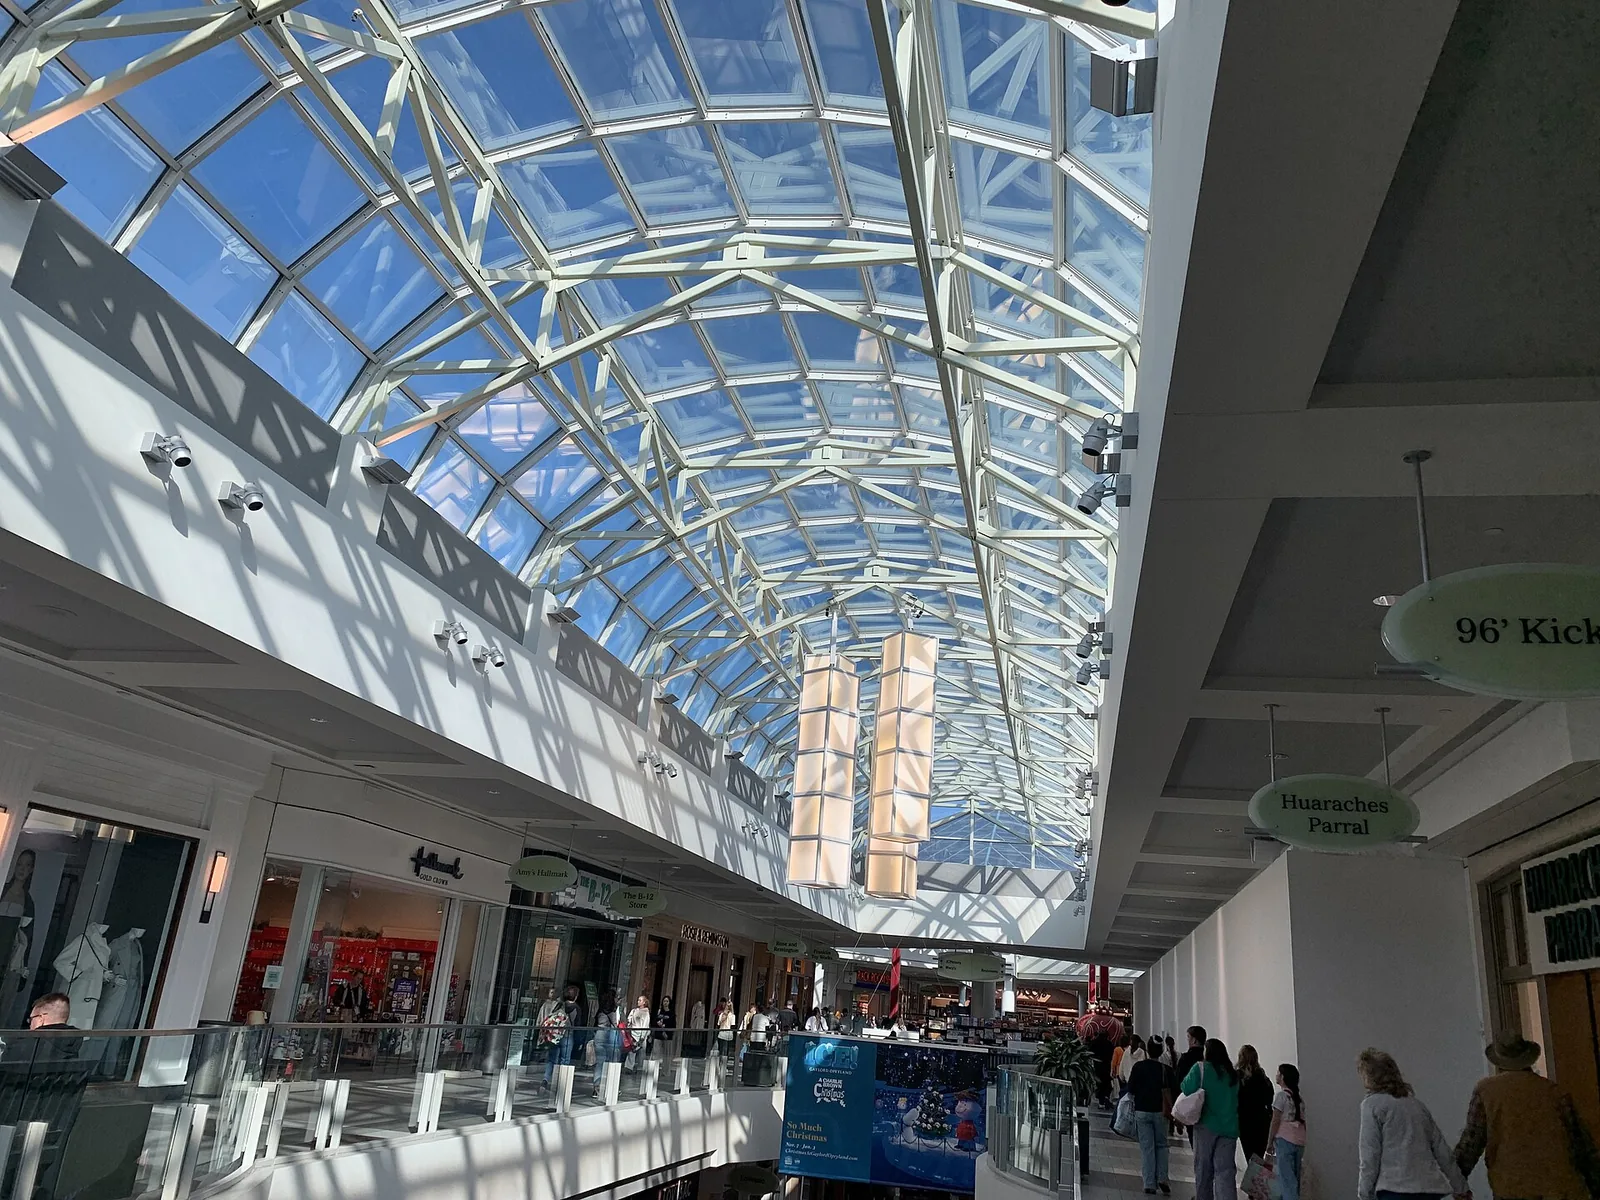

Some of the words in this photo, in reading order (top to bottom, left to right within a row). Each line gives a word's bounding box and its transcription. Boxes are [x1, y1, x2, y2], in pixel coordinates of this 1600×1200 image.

[1456, 617, 1508, 644] 96'
[1518, 617, 1600, 645] Kick
[1281, 794, 1389, 814] Huaraches
[1308, 817, 1370, 835] Parral
[410, 846, 464, 879] Hallmark
[419, 873, 432, 882] GOLD
[432, 876, 448, 886] CROWN
[515, 868, 535, 877] Amy's
[537, 869, 569, 878] Hallmark
[580, 876, 590, 888] THE
[588, 879, 611, 906] B-12
[623, 891, 637, 899] The
[638, 893, 654, 901] B-12
[628, 901, 648, 909] Store
[681, 924, 697, 941] ROSE
[804, 1040, 859, 1070] ICE!
[813, 1083, 845, 1099] Christmas
[786, 1120, 797, 1129] So
[798, 1121, 822, 1132] Much
[786, 1130, 828, 1143] Christmas
